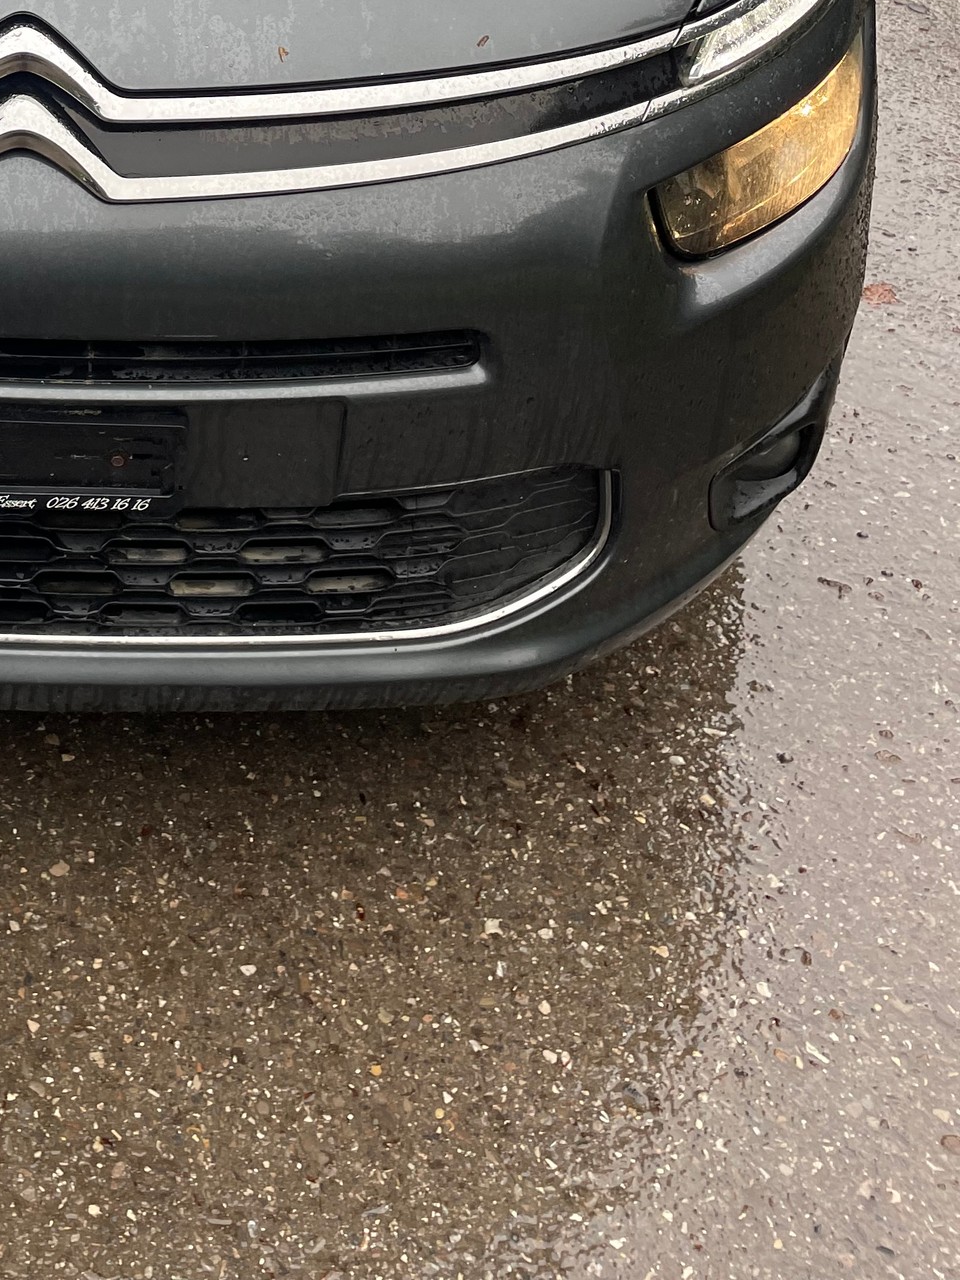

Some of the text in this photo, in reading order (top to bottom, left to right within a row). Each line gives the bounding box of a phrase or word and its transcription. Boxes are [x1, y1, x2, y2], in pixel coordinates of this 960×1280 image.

[46, 496, 80, 510] 026
[81, 497, 110, 511] 413
[110, 497, 131, 511] 16
[131, 498, 152, 511] 16
